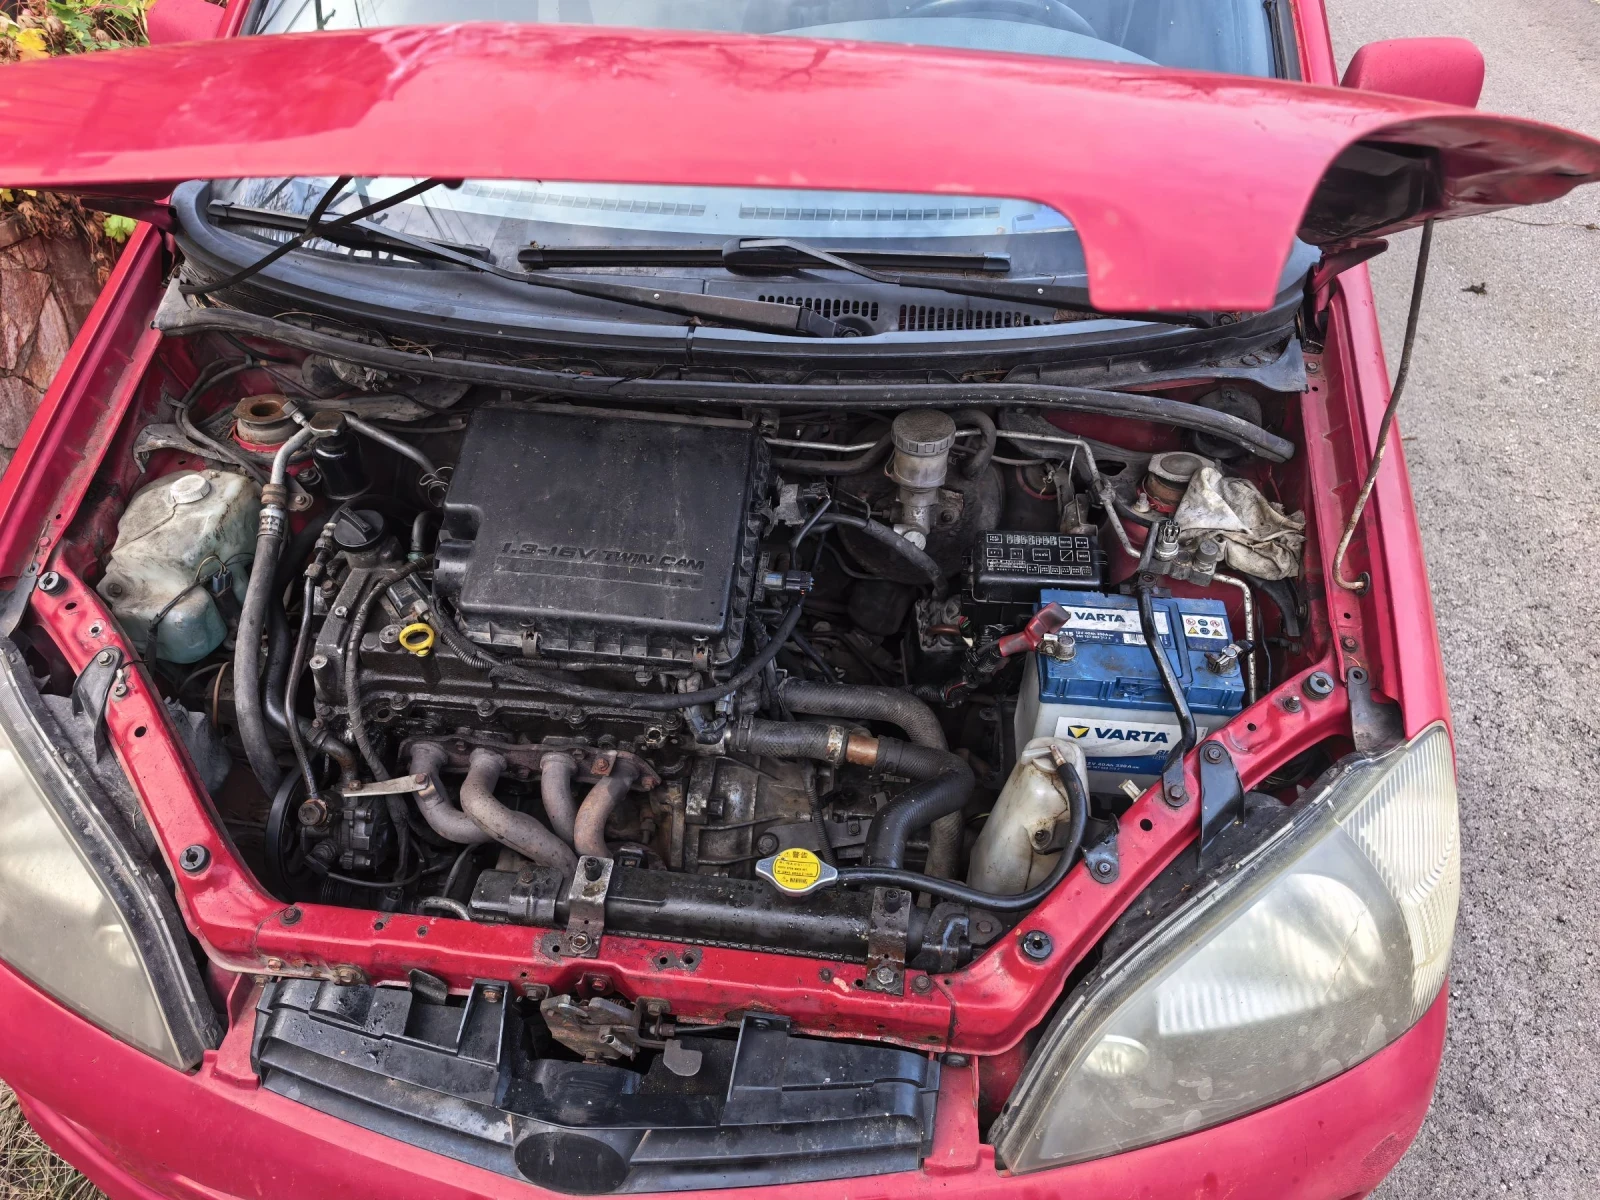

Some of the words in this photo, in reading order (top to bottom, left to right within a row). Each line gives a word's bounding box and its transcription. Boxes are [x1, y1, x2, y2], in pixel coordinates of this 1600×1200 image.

[501, 542, 599, 559] 1.3-16V
[603, 550, 655, 566] TWIN
[659, 556, 705, 571] CAM
[1074, 611, 1126, 623] VARTA
[1094, 728, 1168, 744] VARTA
